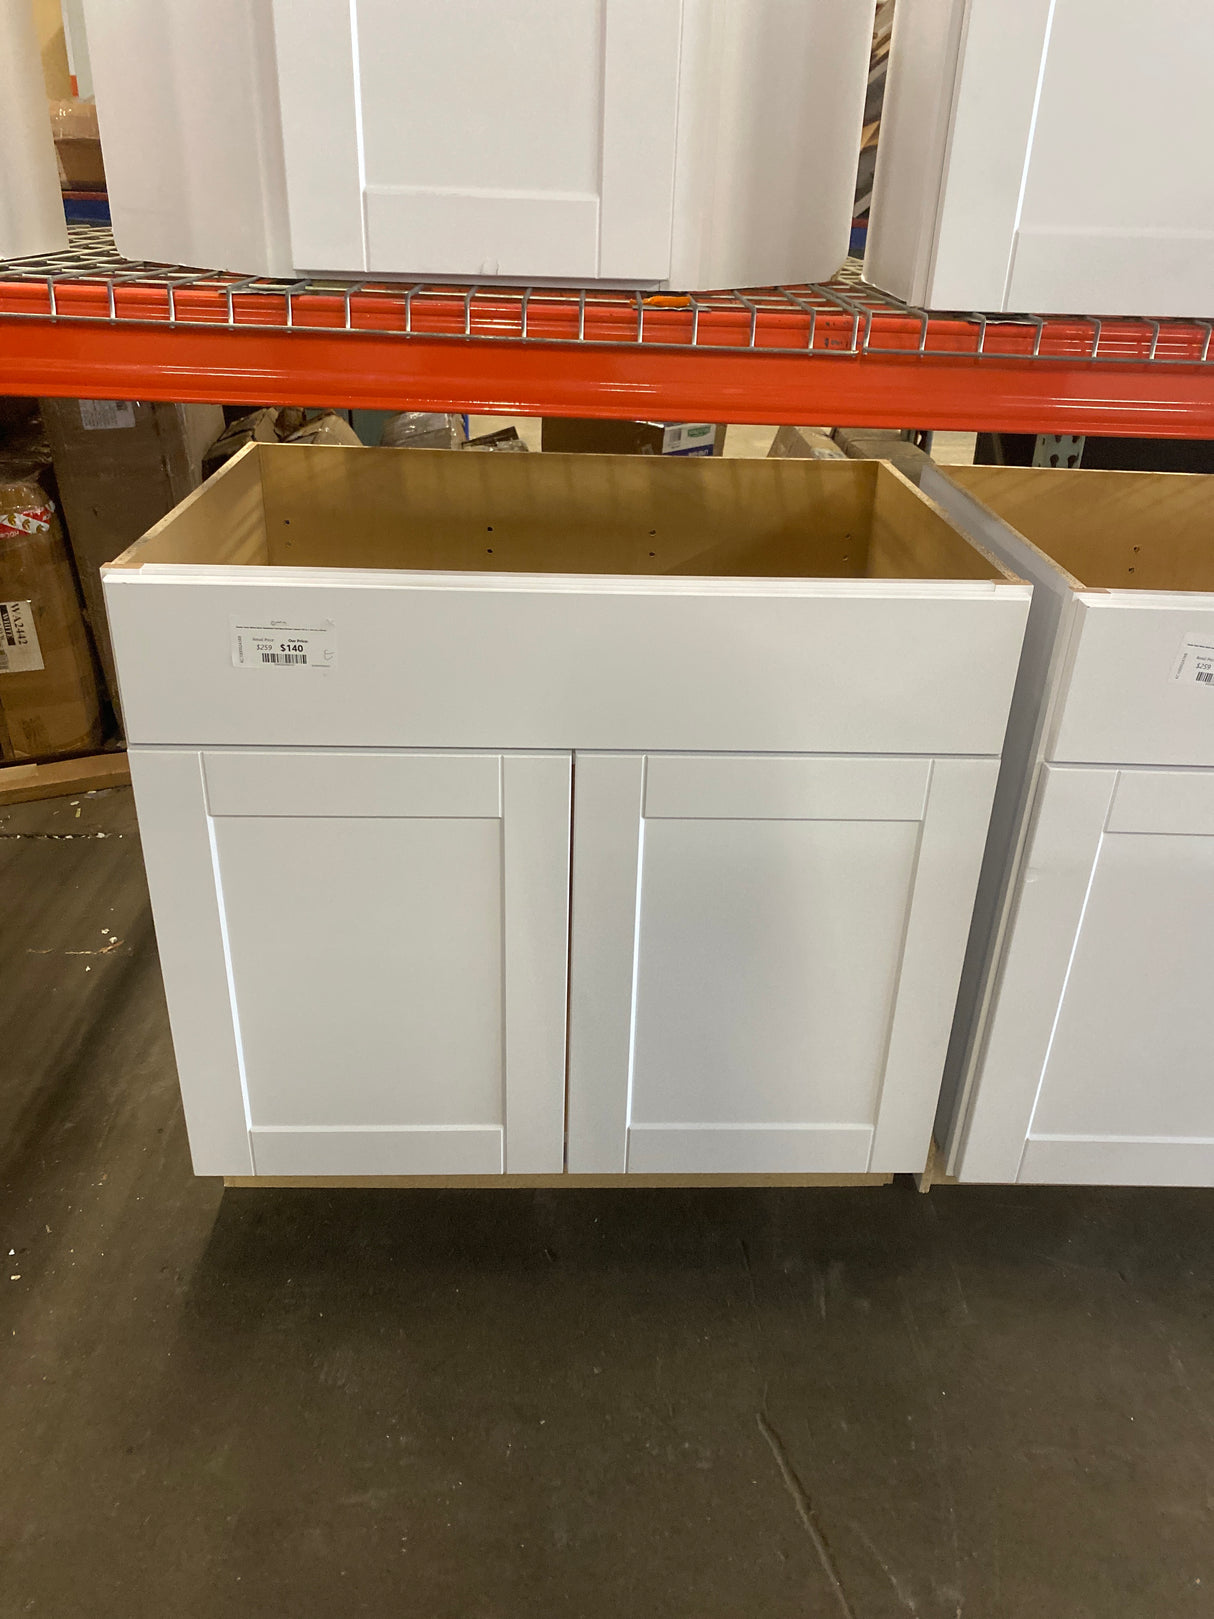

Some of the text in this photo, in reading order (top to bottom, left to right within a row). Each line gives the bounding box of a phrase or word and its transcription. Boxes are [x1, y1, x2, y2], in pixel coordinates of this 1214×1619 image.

[11, 603, 28, 645] WA2442
[280, 643, 304, 652] $140
[1196, 662, 1212, 670] $259
